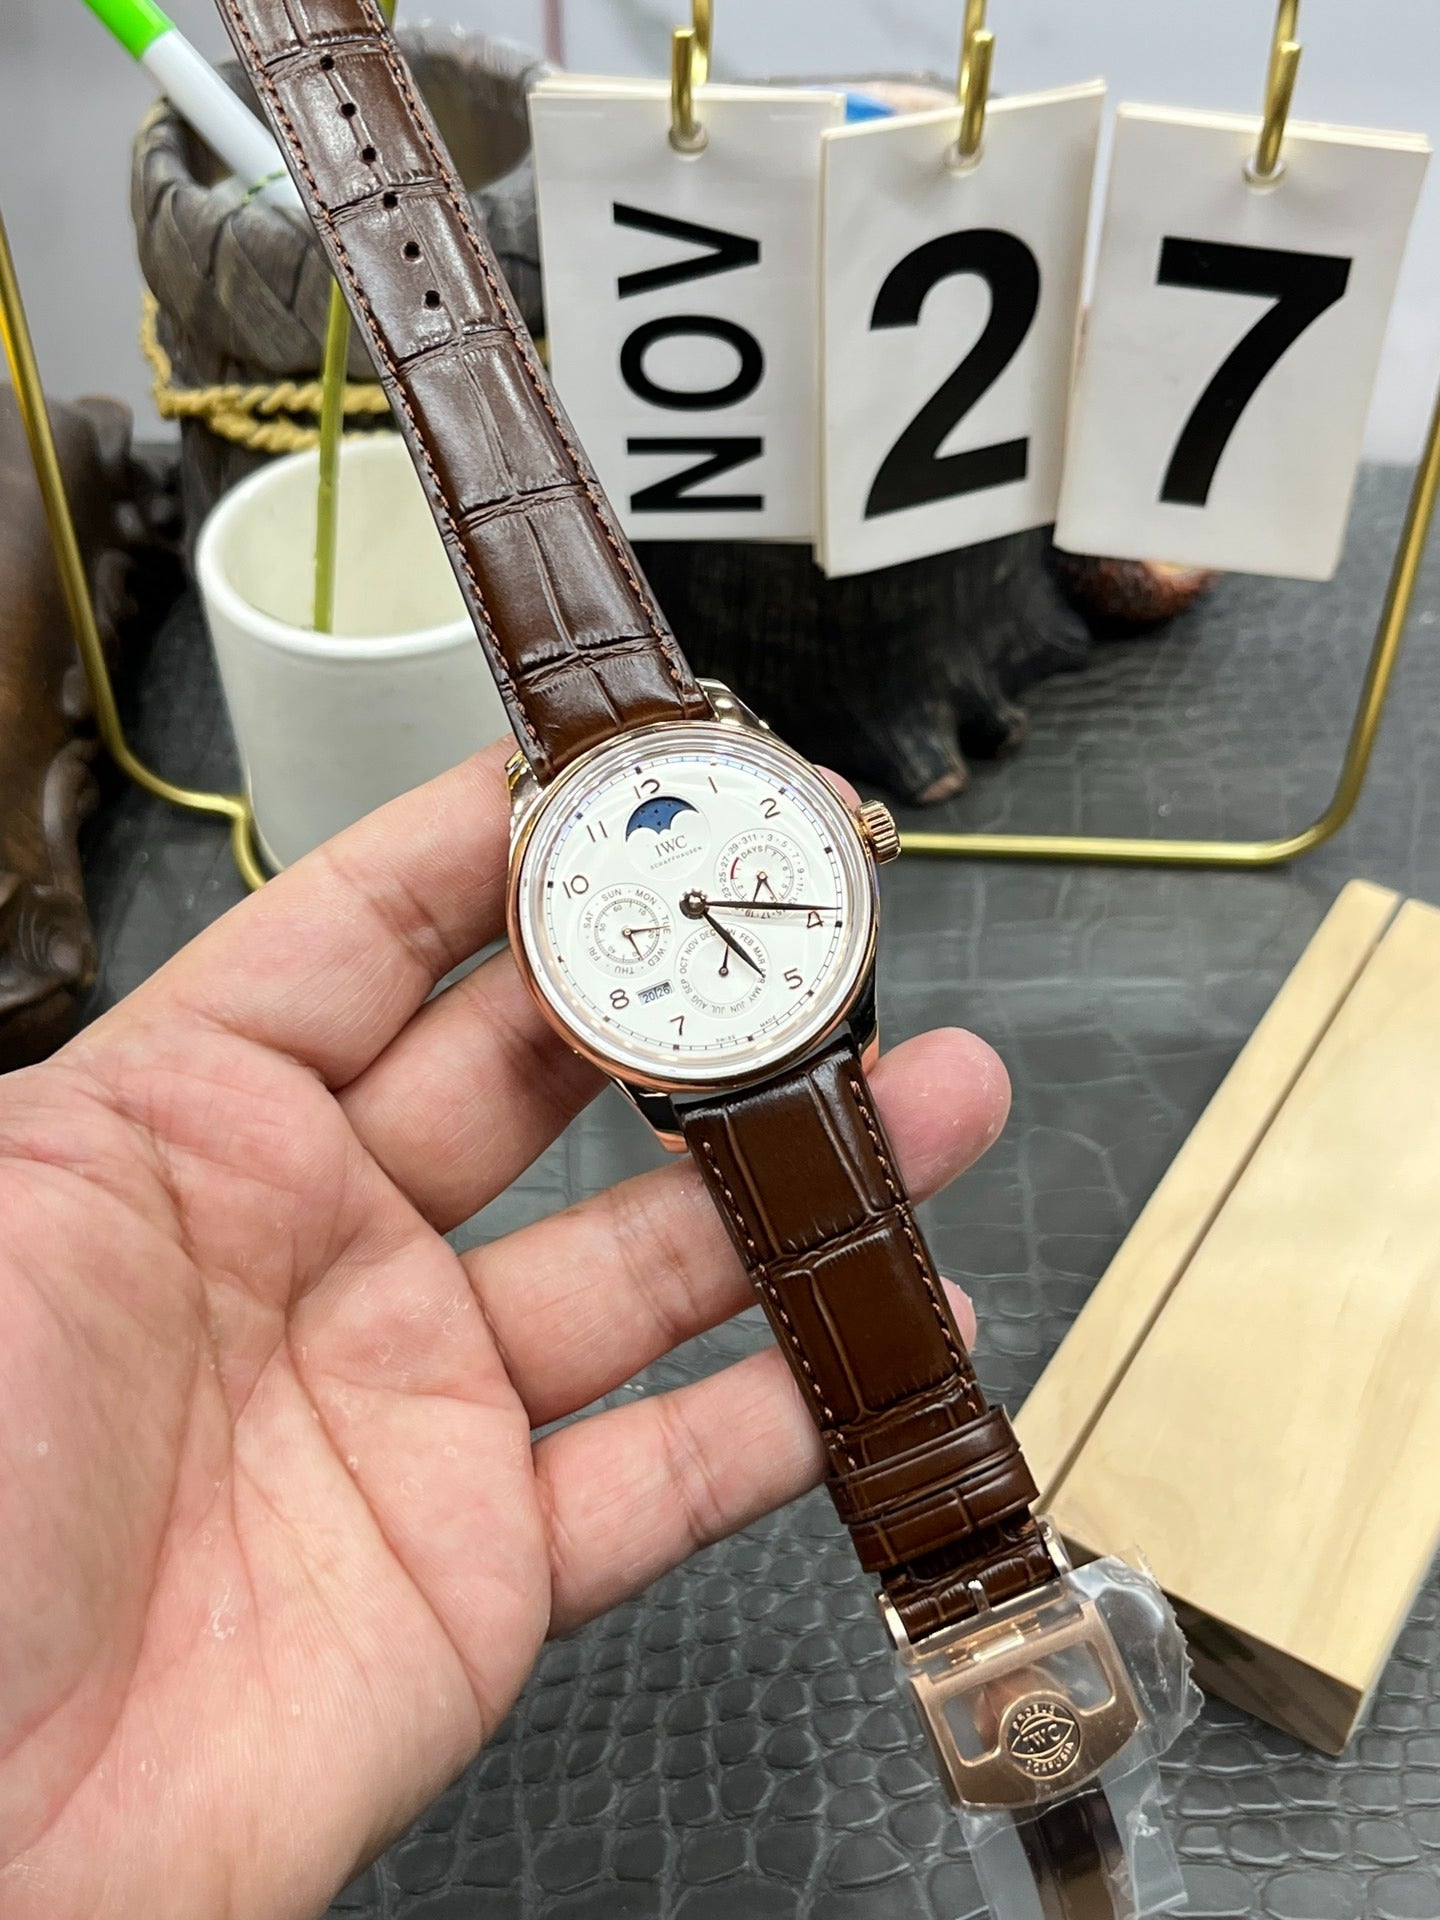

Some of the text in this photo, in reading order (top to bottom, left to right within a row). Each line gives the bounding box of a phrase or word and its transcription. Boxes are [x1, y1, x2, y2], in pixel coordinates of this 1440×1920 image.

[612, 202, 765, 513] NOV
[864, 228, 1041, 521] 2
[1155, 235, 1353, 508] 7
[759, 797, 781, 819] 2
[586, 820, 608, 843] 11
[654, 835, 687, 857] IWC
[740, 845, 763, 859] DAYS
[720, 856, 730, 868] 27
[729, 843, 739, 854] 29
[562, 874, 589, 899] 10
[601, 888, 622, 902] SUN
[635, 889, 657, 905] MON
[583, 911, 594, 929] SAT
[806, 910, 824, 929] 4
[699, 928, 717, 941] DEC
[739, 933, 755, 947] FEB
[588, 946, 601, 962] FRI
[684, 938, 699, 955] NOV
[753, 946, 766, 965] MAR
[647, 948, 666, 967] WED
[679, 957, 689, 974] OCT
[614, 966, 635, 975] THU
[783, 967, 804, 990] 5
[680, 978, 693, 994] SEP
[749, 987, 762, 1002] MAY
[609, 988, 630, 1010] 8
[691, 995, 708, 1010] AUG
[730, 1001, 746, 1014] JUN
[711, 1005, 725, 1015] JUL
[670, 1015, 685, 1036] 7
